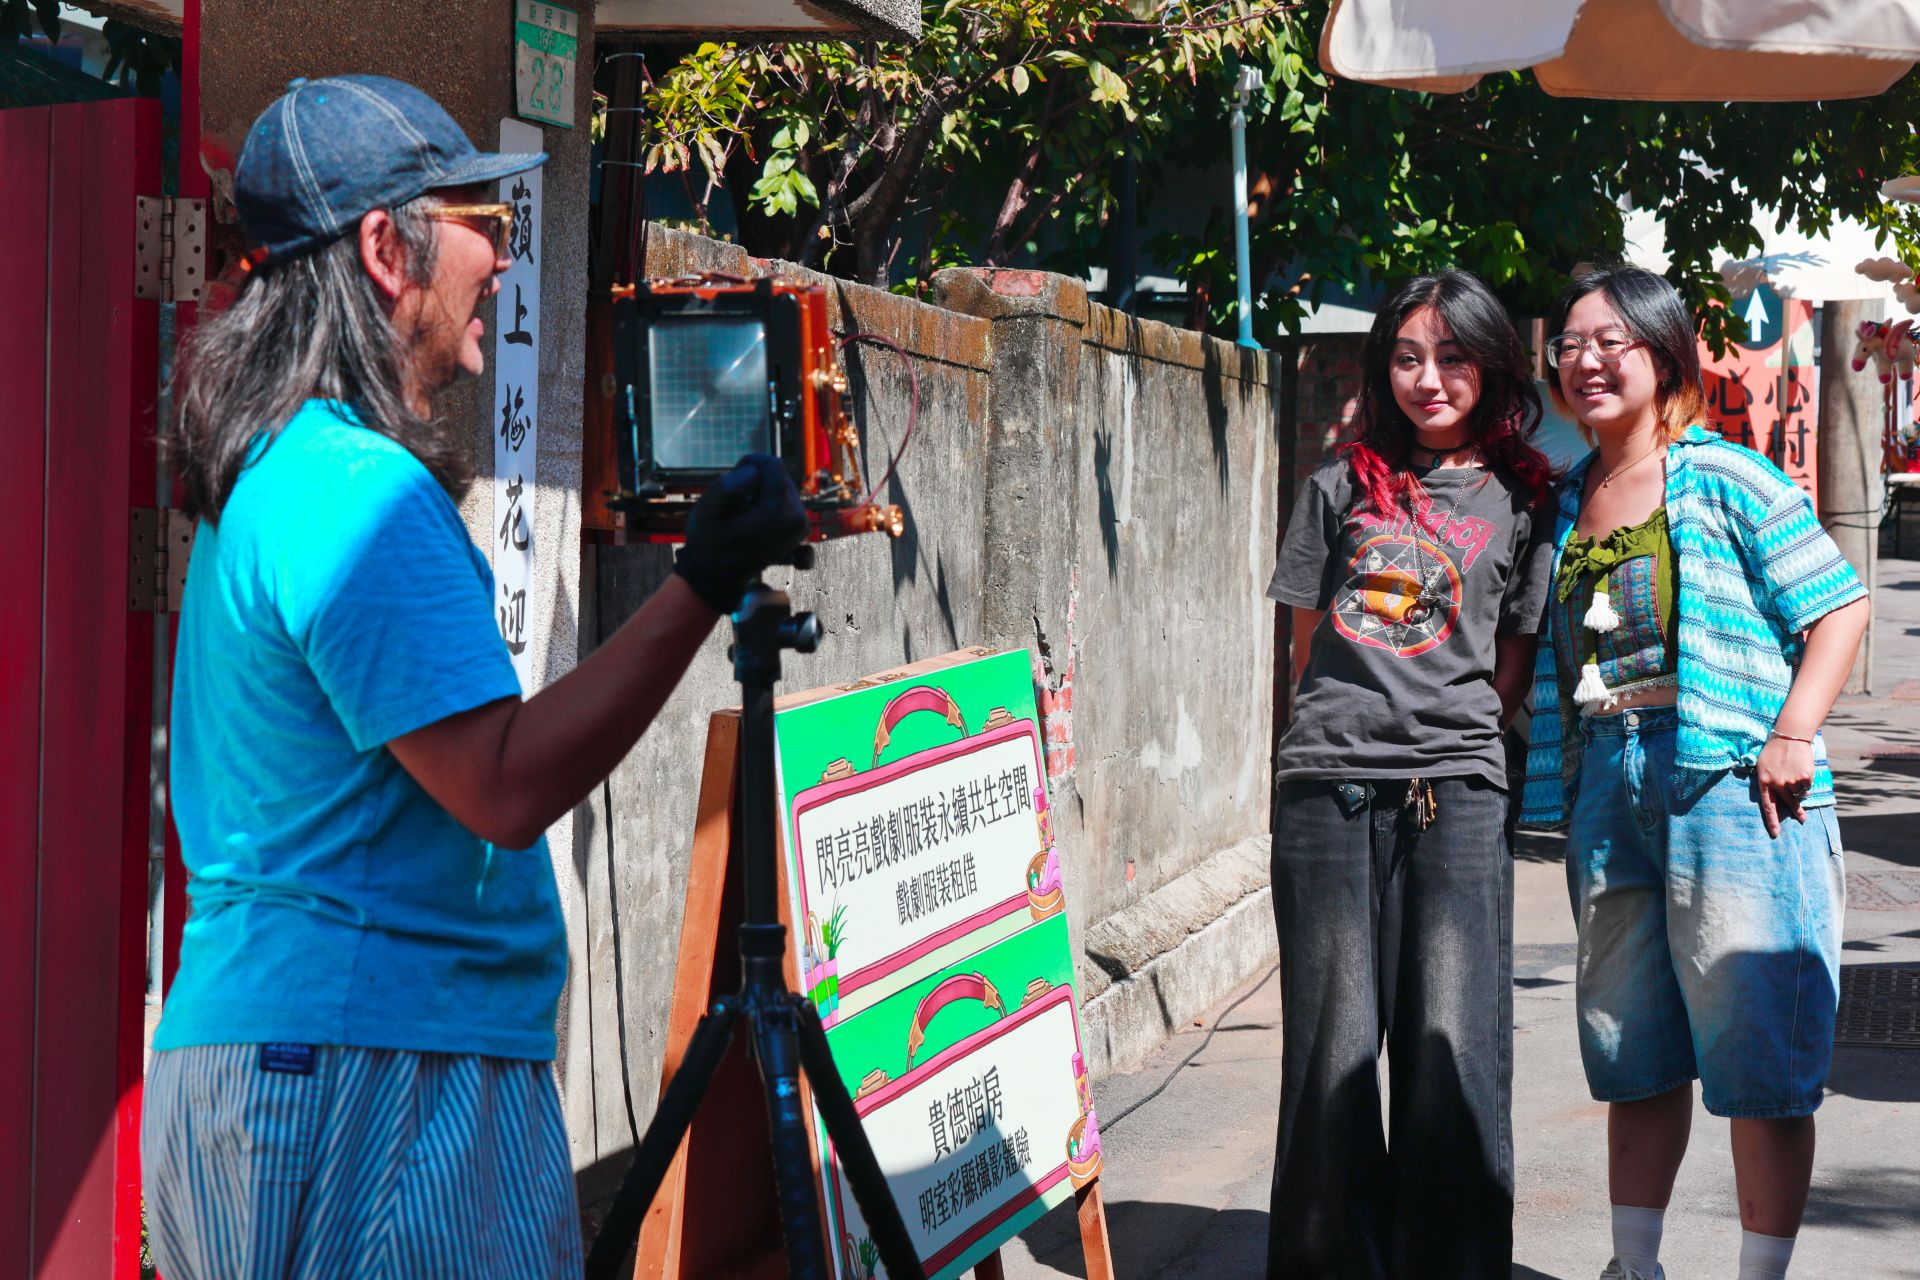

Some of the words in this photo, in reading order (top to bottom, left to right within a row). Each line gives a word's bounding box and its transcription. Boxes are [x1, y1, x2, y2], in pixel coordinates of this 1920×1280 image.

[815, 764, 1032, 895] 閃亮亮戲劇服裝永續共生空間
[896, 852, 978, 926] 戲劇服裝租借
[928, 1065, 1004, 1163] 貴德暗房
[918, 1125, 1033, 1236] 明室彩顯攝影體驗
